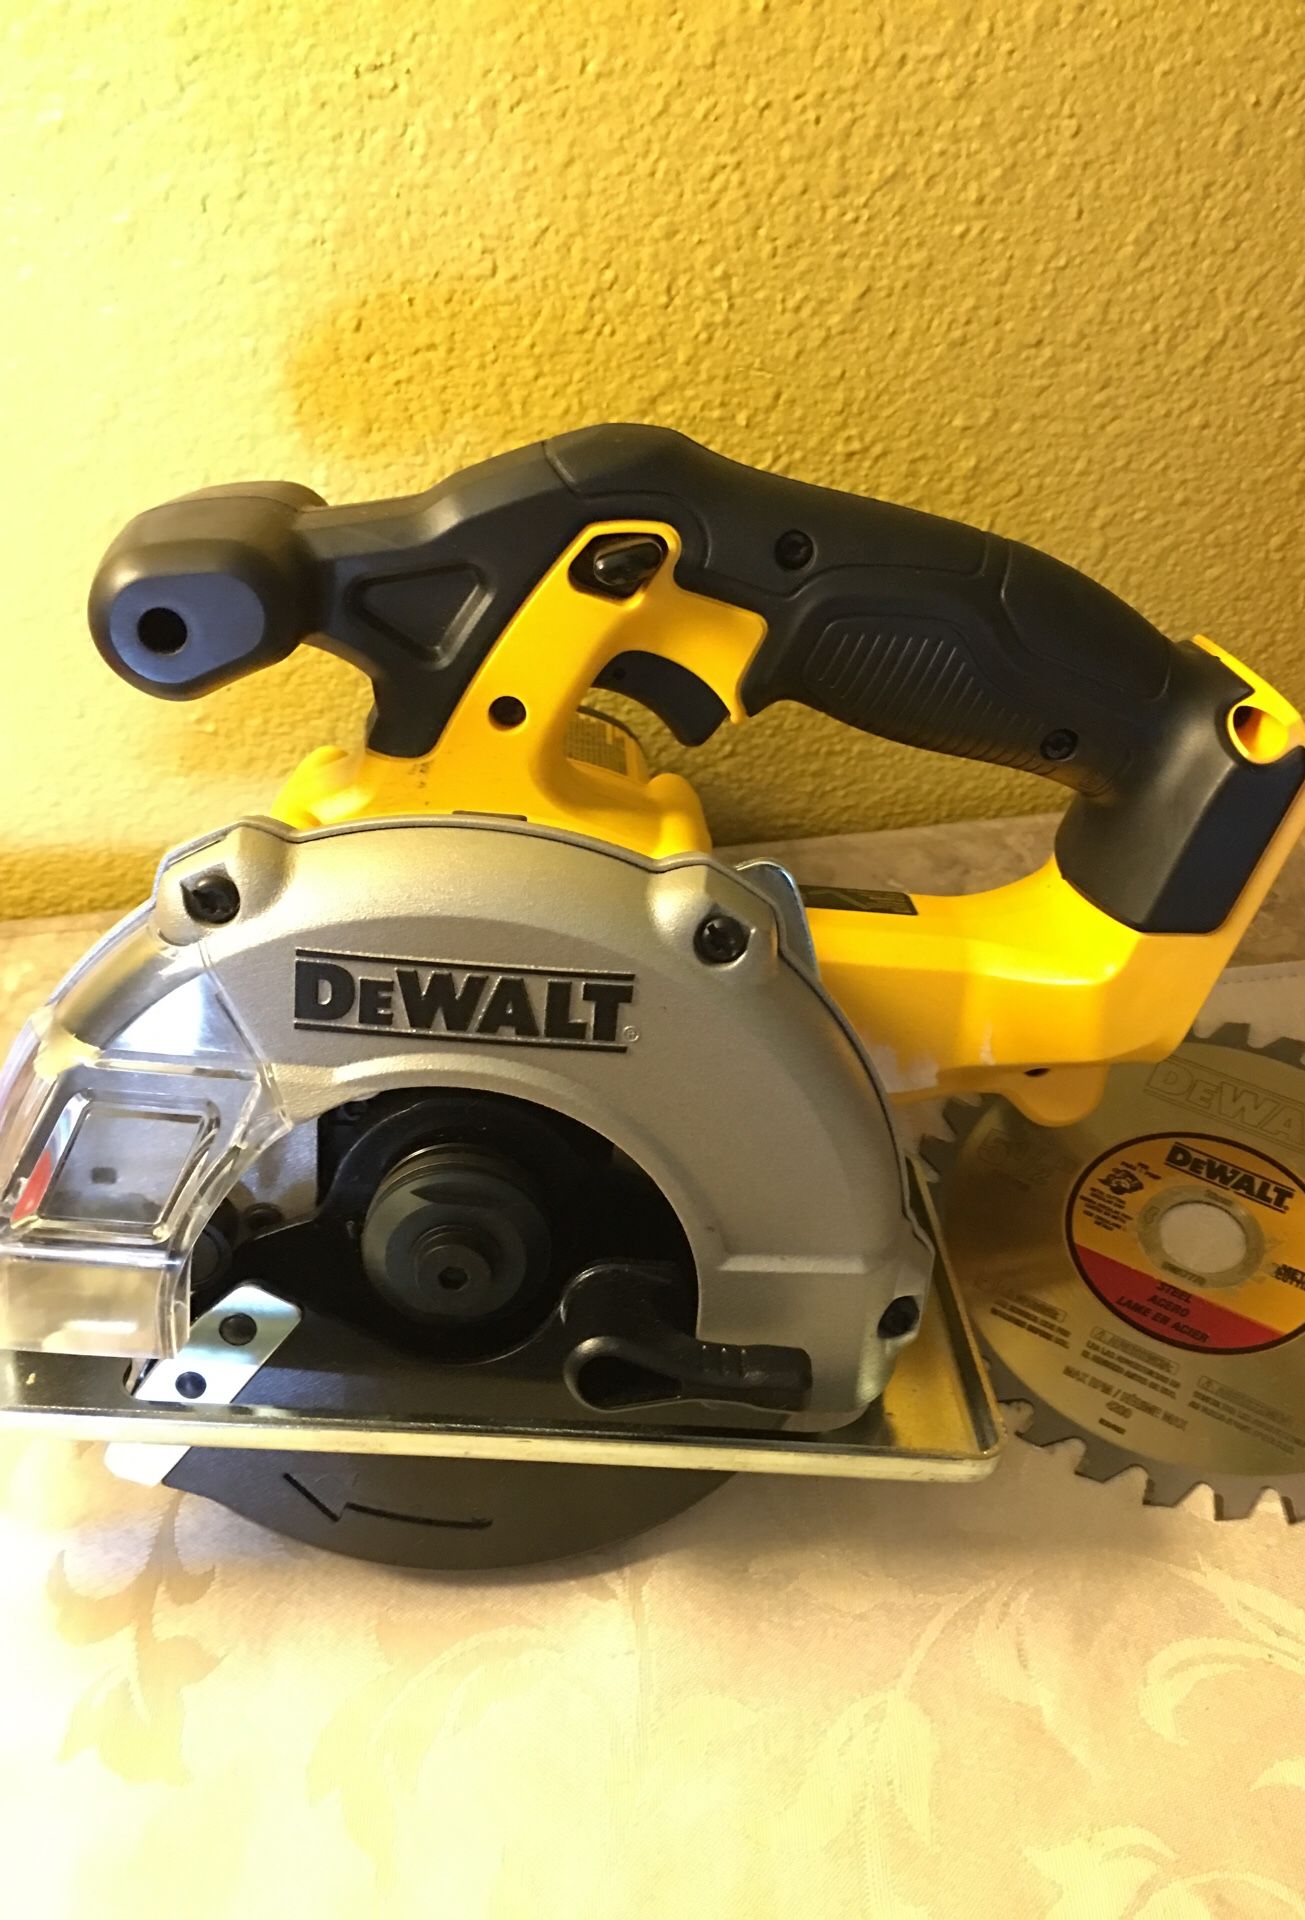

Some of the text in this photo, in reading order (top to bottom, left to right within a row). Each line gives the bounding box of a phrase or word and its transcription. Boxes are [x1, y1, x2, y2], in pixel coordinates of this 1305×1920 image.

[1156, 1281, 1193, 1304] STEEL
[1147, 1294, 1190, 1317] ACERO
[1116, 1296, 1210, 1344] LAME EN ACIER
